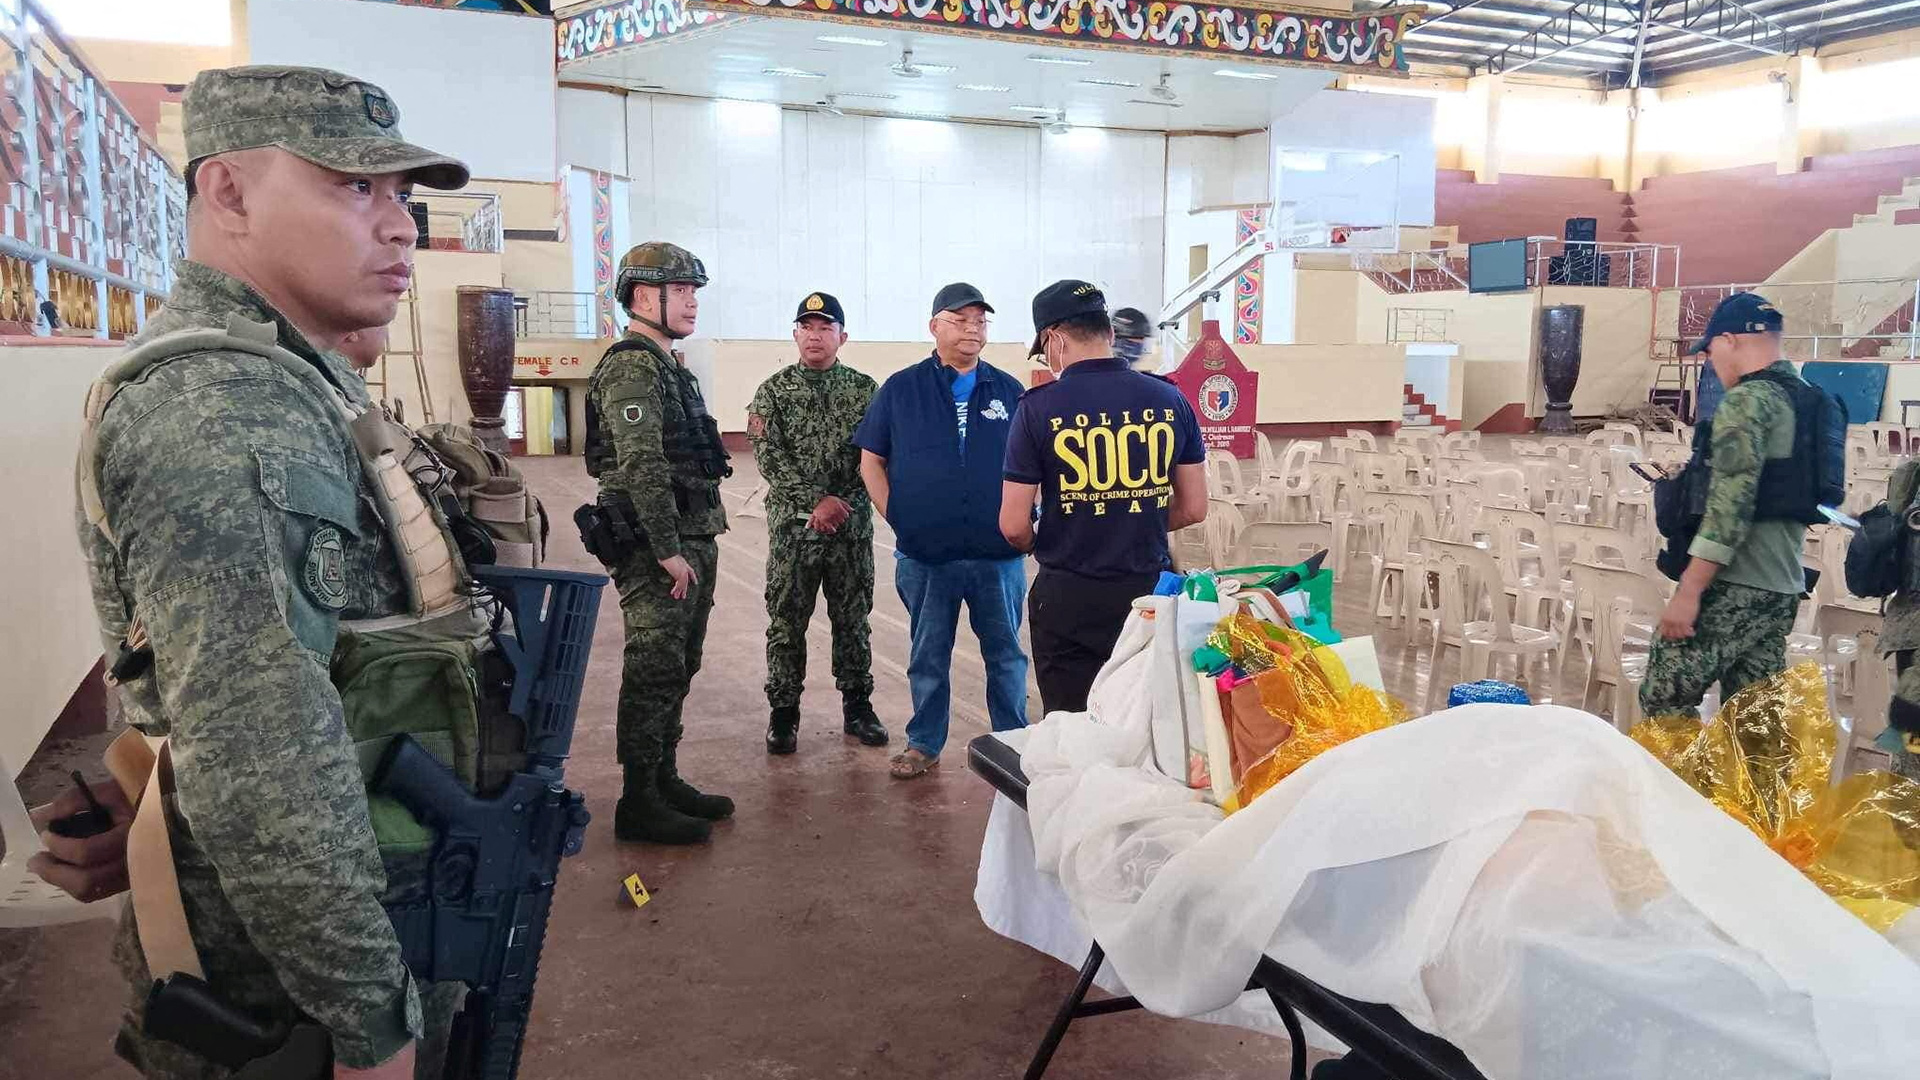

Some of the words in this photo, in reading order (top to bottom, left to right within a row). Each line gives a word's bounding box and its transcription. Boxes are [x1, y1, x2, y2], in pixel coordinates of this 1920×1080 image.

[513, 357, 552, 365] FEMALE
[1050, 409, 1175, 431] POLICE
[1053, 422, 1175, 491] SOCO
[1060, 492, 1088, 501] SCENE
[1089, 491, 1100, 501] OF
[1101, 489, 1130, 499] CRIME
[1062, 495, 1168, 515] TEAM
[635, 881, 643, 896] 4
